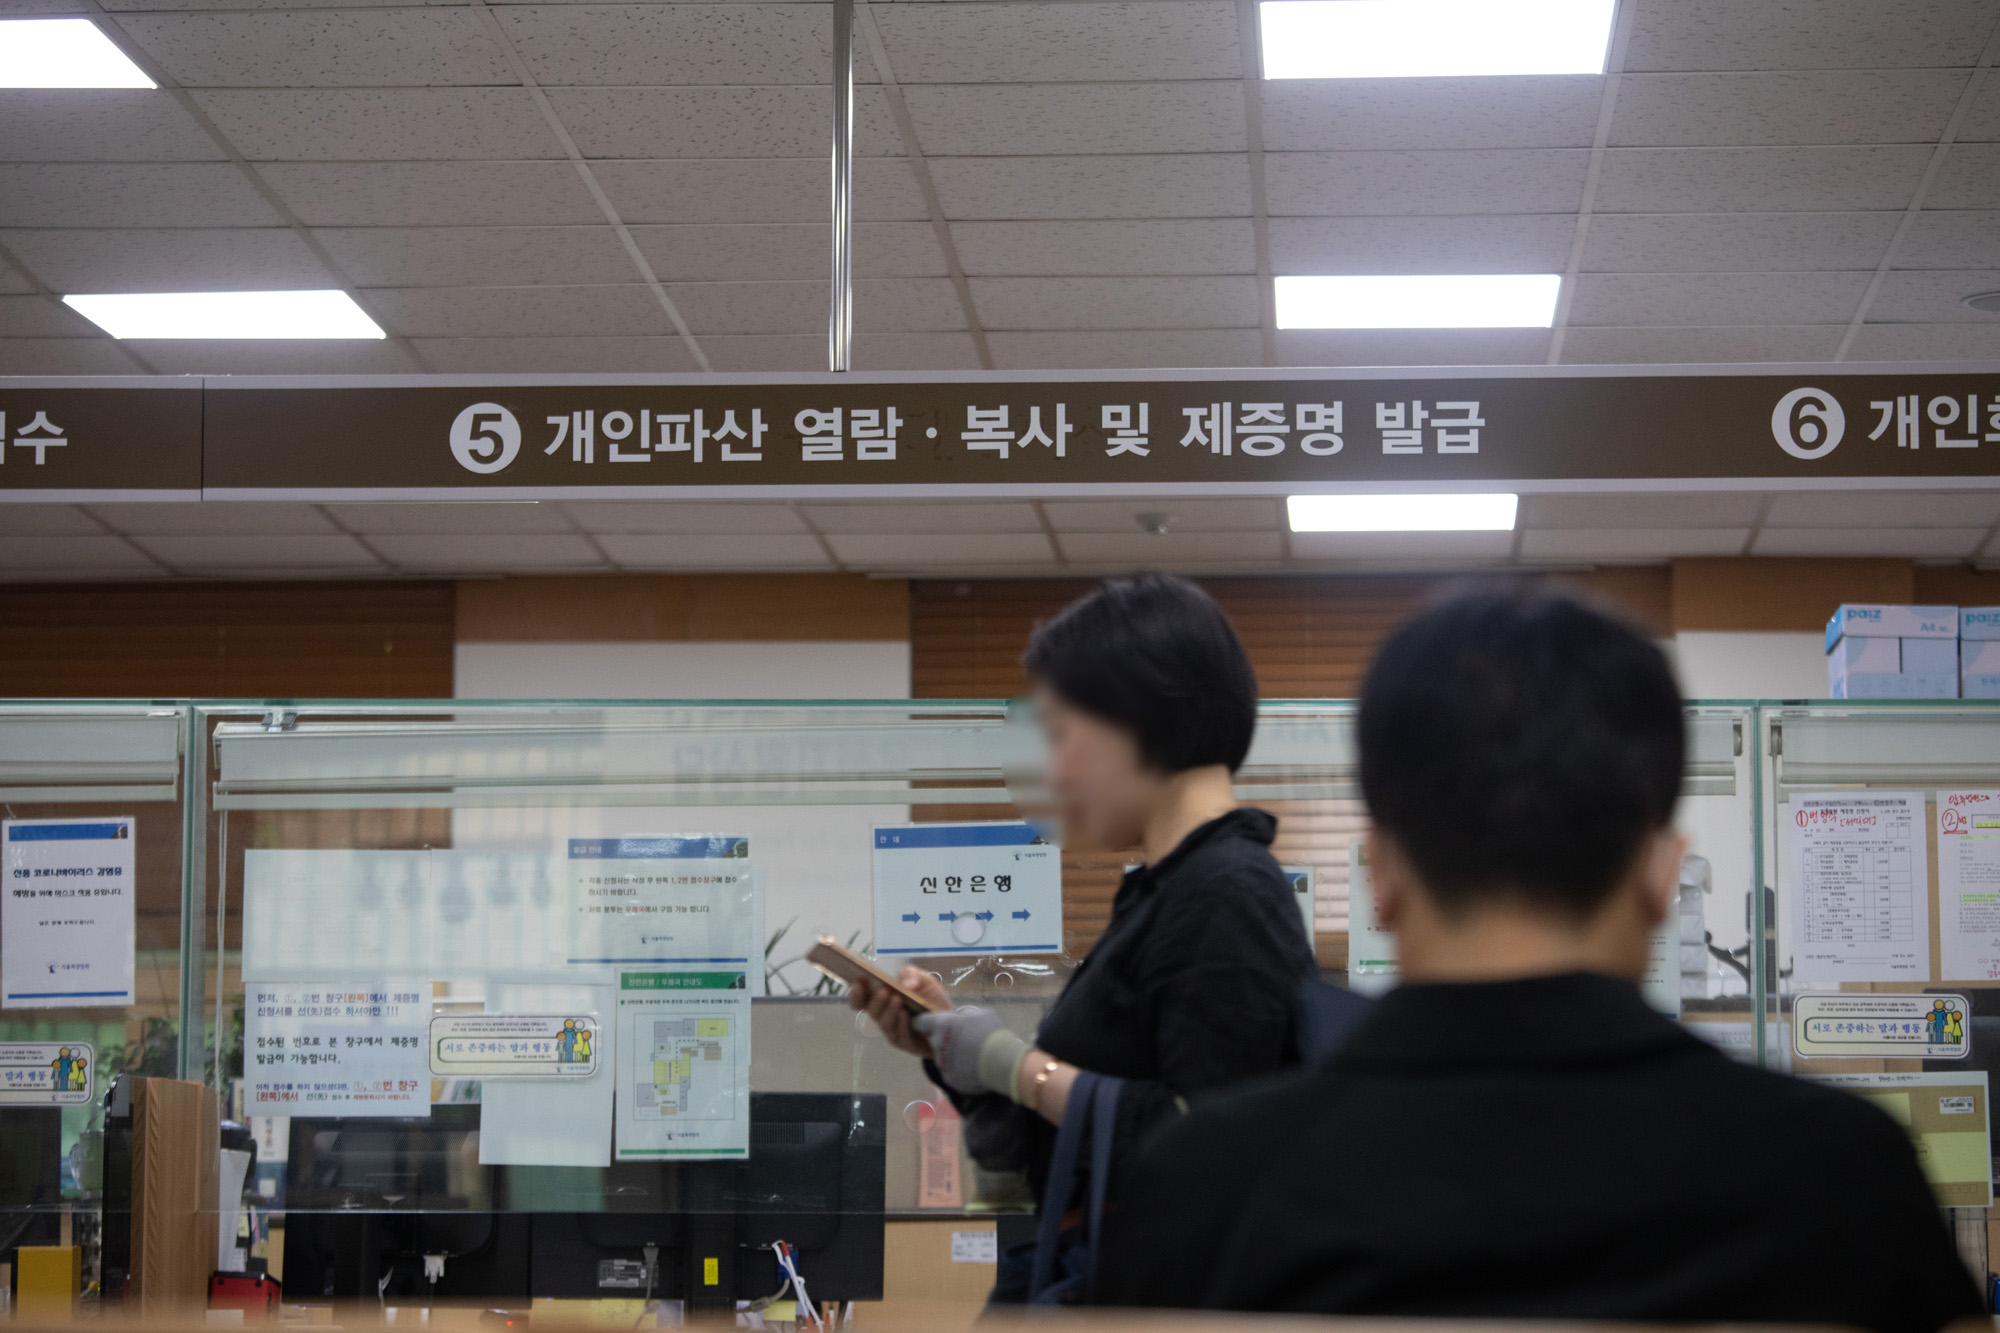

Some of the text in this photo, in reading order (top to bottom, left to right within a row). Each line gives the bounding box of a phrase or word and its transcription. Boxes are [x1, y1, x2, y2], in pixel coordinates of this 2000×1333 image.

[0, 411, 68, 465] 수
[544, 408, 768, 464] 개인파산
[794, 406, 903, 461] 열람
[960, 403, 1073, 459] 복사
[1102, 402, 1150, 457] 및
[1179, 401, 1344, 456] 제증명
[1375, 400, 1485, 455] 발급
[34, 868, 94, 877] 코로나바이러스
[1811, 1023, 1832, 1033] 서로
[1835, 1023, 1875, 1033] 존중하는
[1902, 1023, 1921, 1033] 행동
